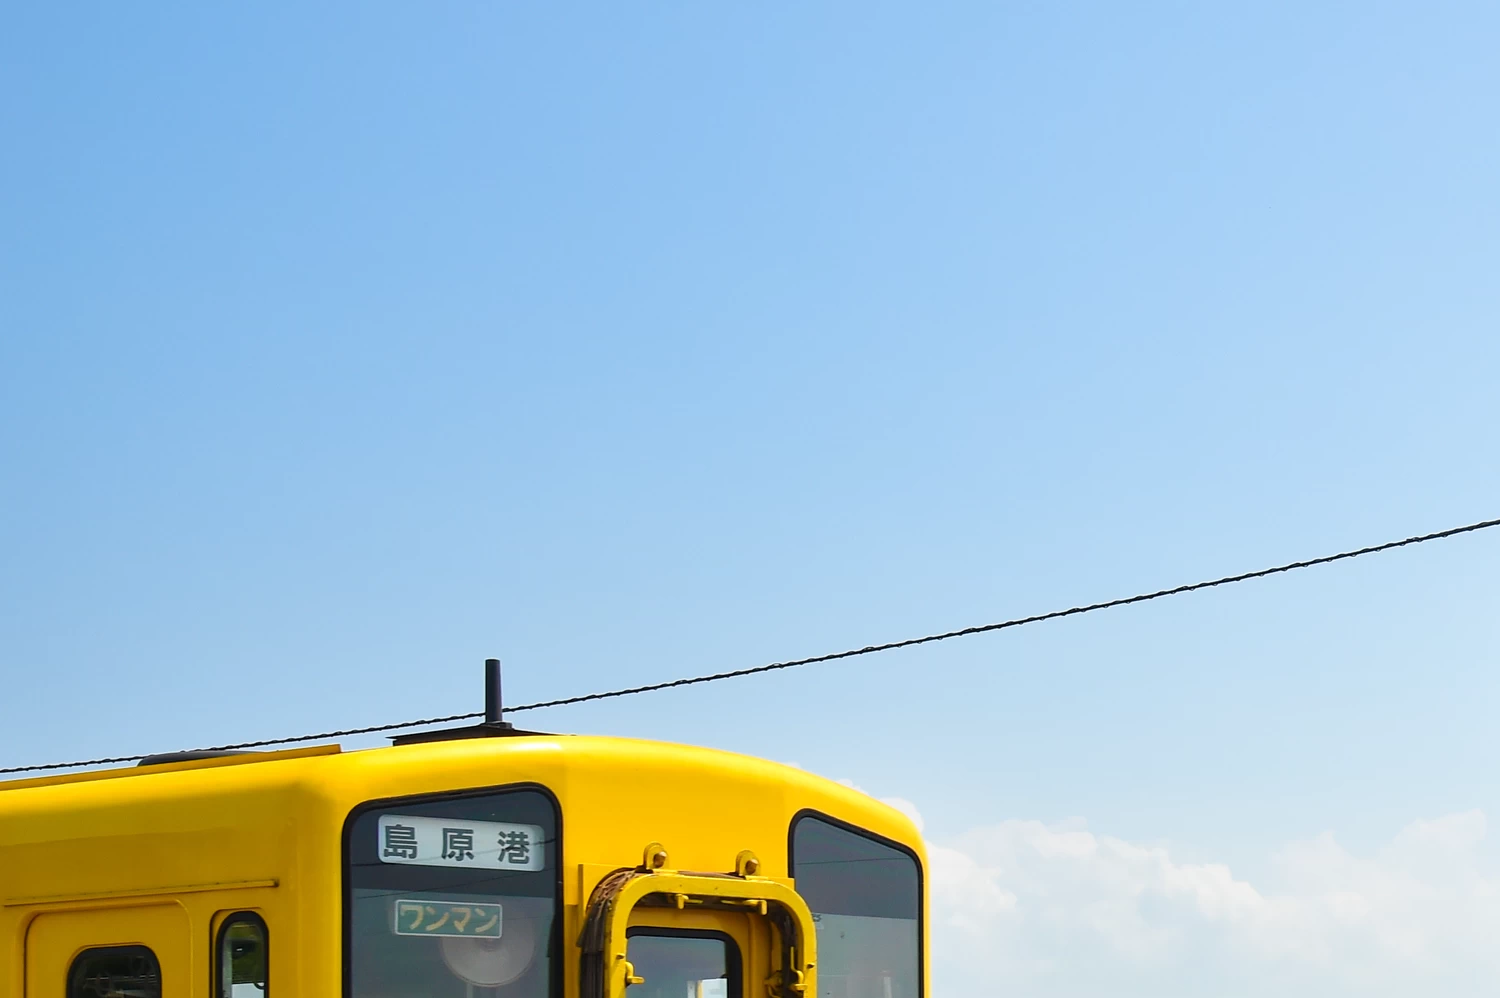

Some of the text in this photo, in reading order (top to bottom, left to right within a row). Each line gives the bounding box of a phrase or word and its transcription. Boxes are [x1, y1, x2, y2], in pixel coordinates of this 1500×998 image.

[383, 823, 530, 865] 島原港
[400, 904, 498, 933] ワンマン
